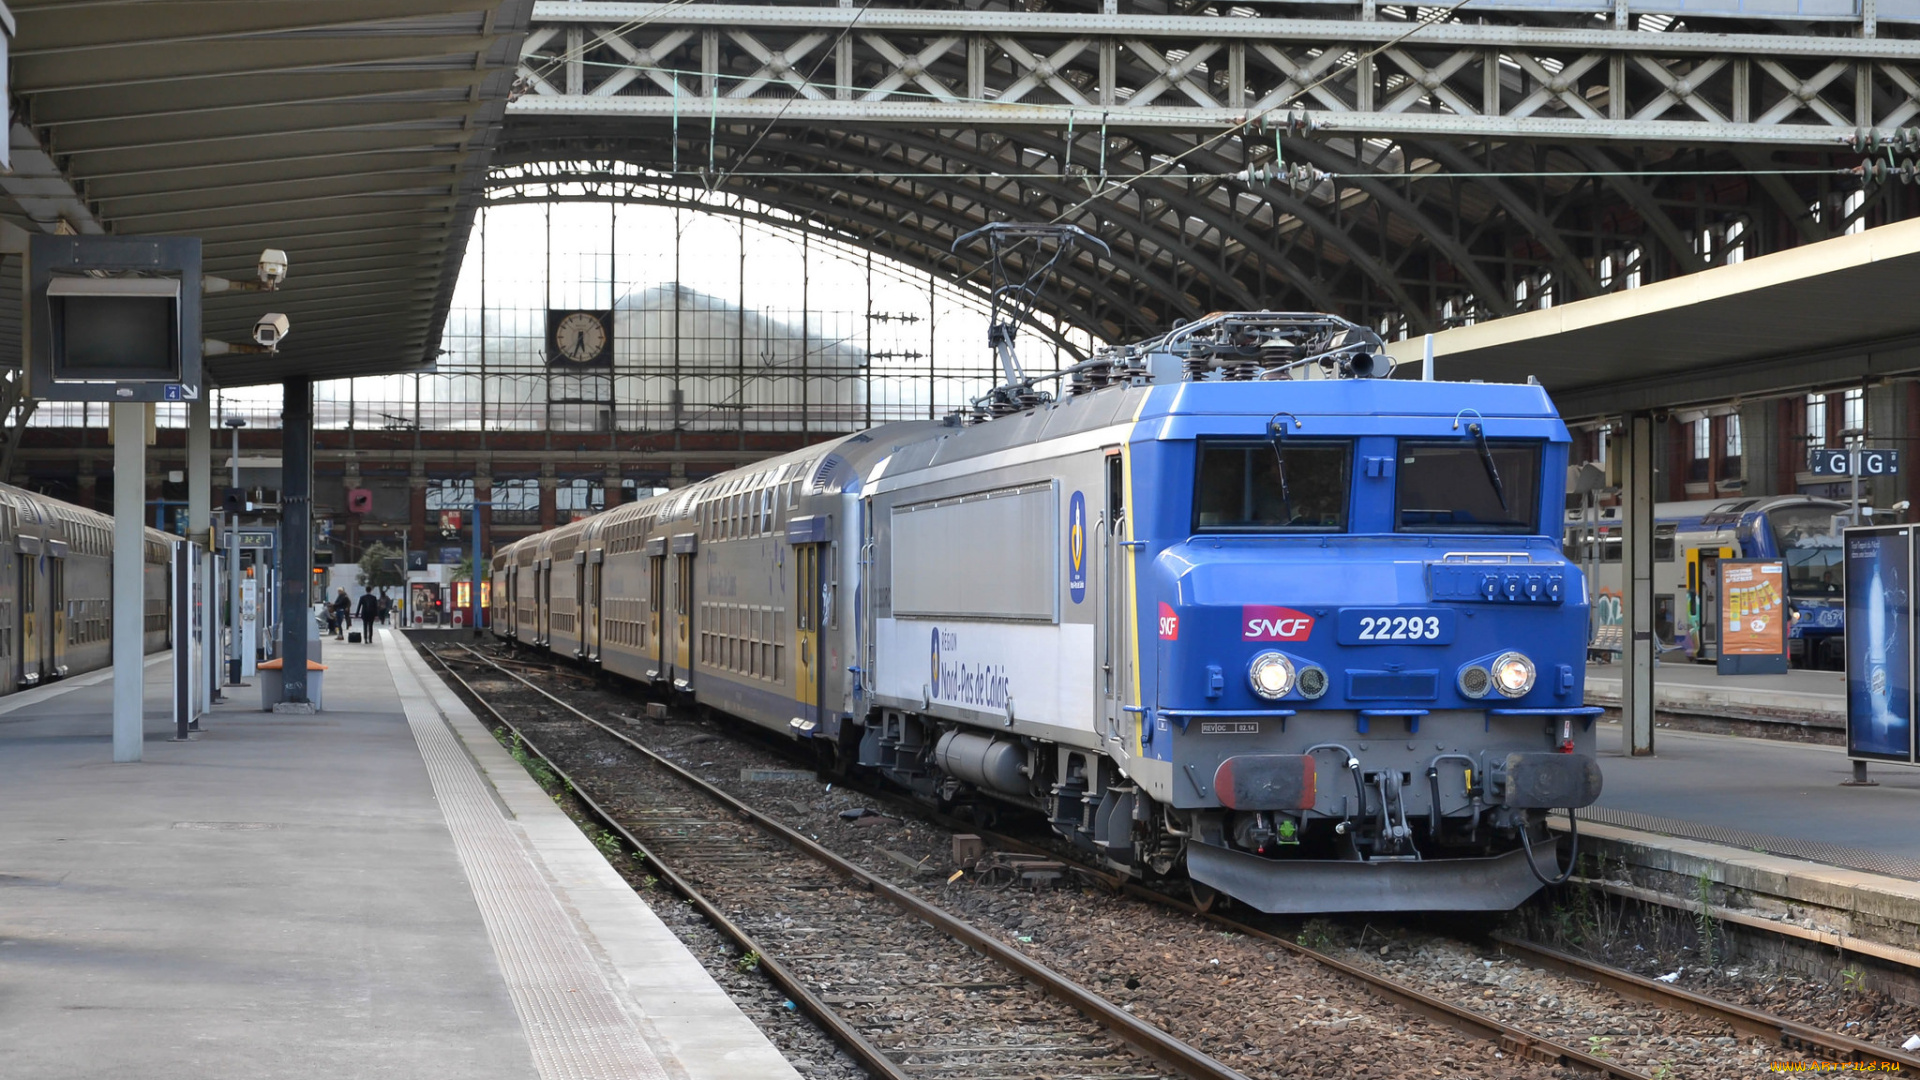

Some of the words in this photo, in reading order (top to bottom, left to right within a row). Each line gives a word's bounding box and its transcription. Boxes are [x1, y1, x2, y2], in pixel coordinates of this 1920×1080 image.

[169, 390, 176, 399] 4
[1829, 454, 1846, 474] G
[1866, 454, 1883, 474] G
[415, 557, 422, 566] 4
[1488, 584, 1494, 592] E
[1509, 584, 1516, 592] C
[1531, 584, 1537, 592] B
[1552, 584, 1558, 592] A
[1159, 616, 1177, 636] SNCF
[1244, 618, 1310, 638] SNCF
[1358, 616, 1440, 640] 22293
[941, 660, 974, 704] Nord-Pas
[975, 662, 984, 706] de
[985, 665, 1009, 710] Calais
[1203, 723, 1216, 732] REV
[1238, 723, 1255, 732] 02.14
